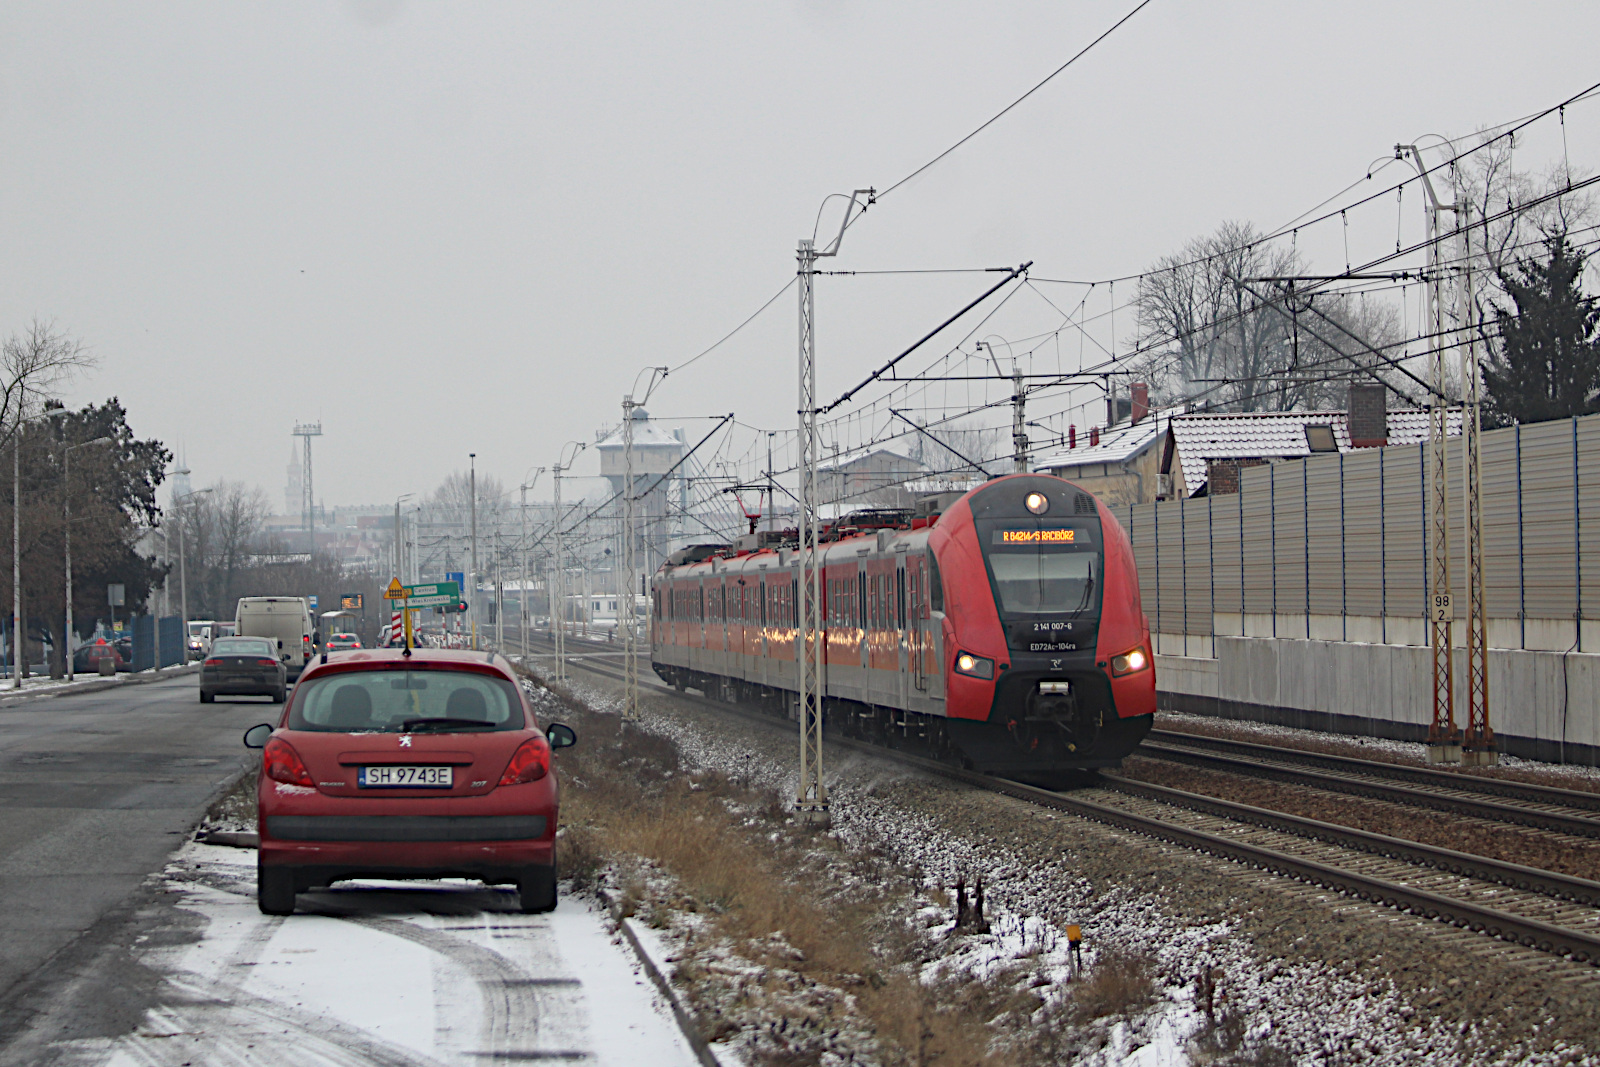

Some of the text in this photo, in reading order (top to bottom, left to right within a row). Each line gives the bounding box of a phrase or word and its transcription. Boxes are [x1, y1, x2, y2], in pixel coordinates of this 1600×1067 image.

[1003, 529, 1074, 541] R 64214/5 RACIBÓRZ
[414, 586, 436, 594] Centrum
[1435, 595, 1449, 607] 98
[1438, 609, 1445, 621] 2
[1033, 622, 1073, 631] 2 141 007-6
[370, 768, 448, 783] SH 9743E
[470, 780, 488, 788] 207
